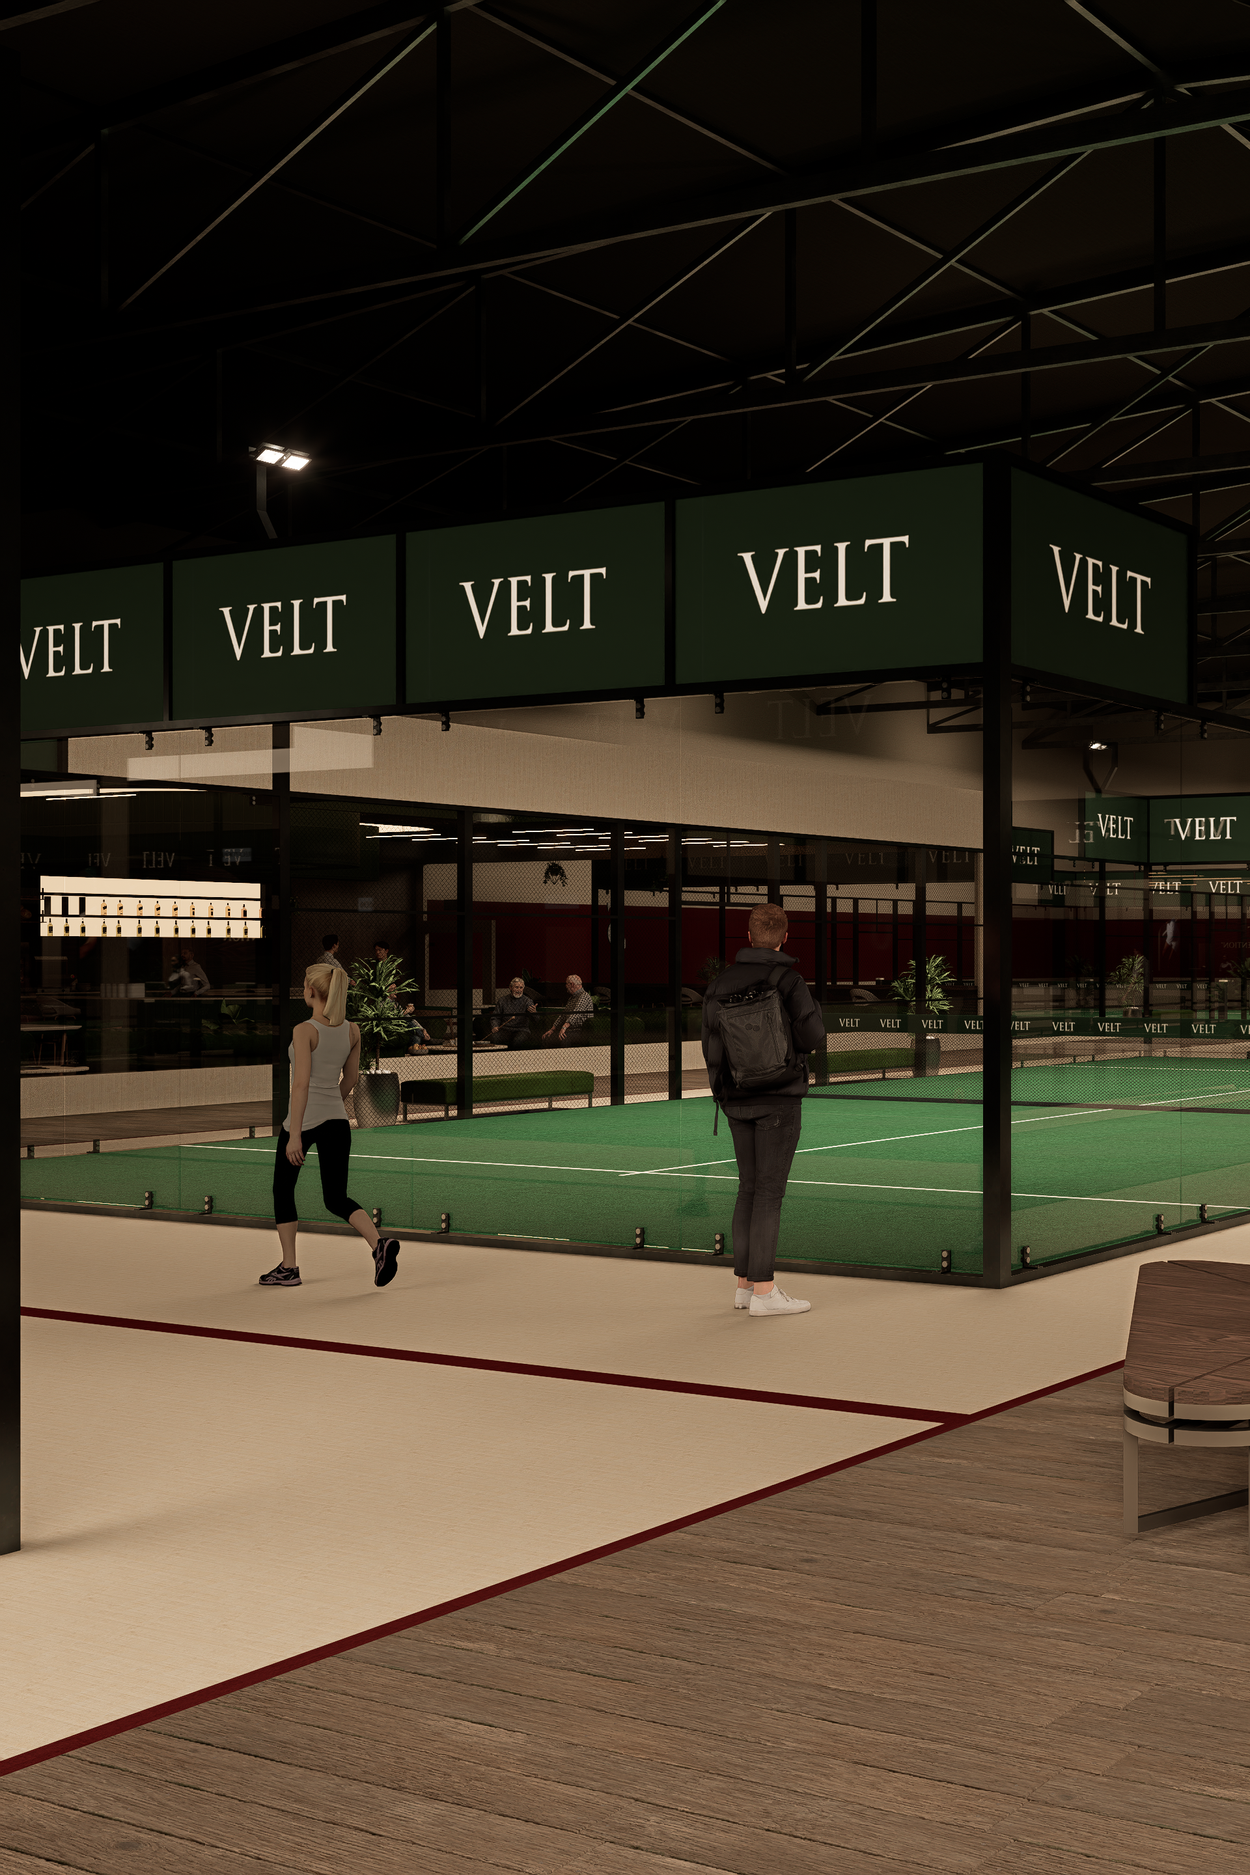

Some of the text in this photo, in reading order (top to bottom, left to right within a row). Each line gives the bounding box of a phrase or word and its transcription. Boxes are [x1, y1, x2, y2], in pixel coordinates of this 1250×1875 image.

[737, 534, 910, 614] VELT
[1048, 543, 1152, 635] VELT
[459, 566, 607, 639] VELT
[219, 594, 347, 661] VELT
[20, 617, 121, 680] VELT
[1097, 813, 1134, 840] VELT
[1174, 816, 1237, 841] VELT
[1089, 882, 1122, 896] VLT
[1209, 880, 1243, 894] VELT
[839, 1018, 860, 1028] VELT
[880, 1018, 902, 1029] VELT
[922, 1019, 944, 1029] VELT
[1052, 1021, 1075, 1032] VELT
[1097, 1022, 1121, 1032] VELT
[1144, 1023, 1169, 1033] VELT
[1191, 1024, 1216, 1034] VELT
